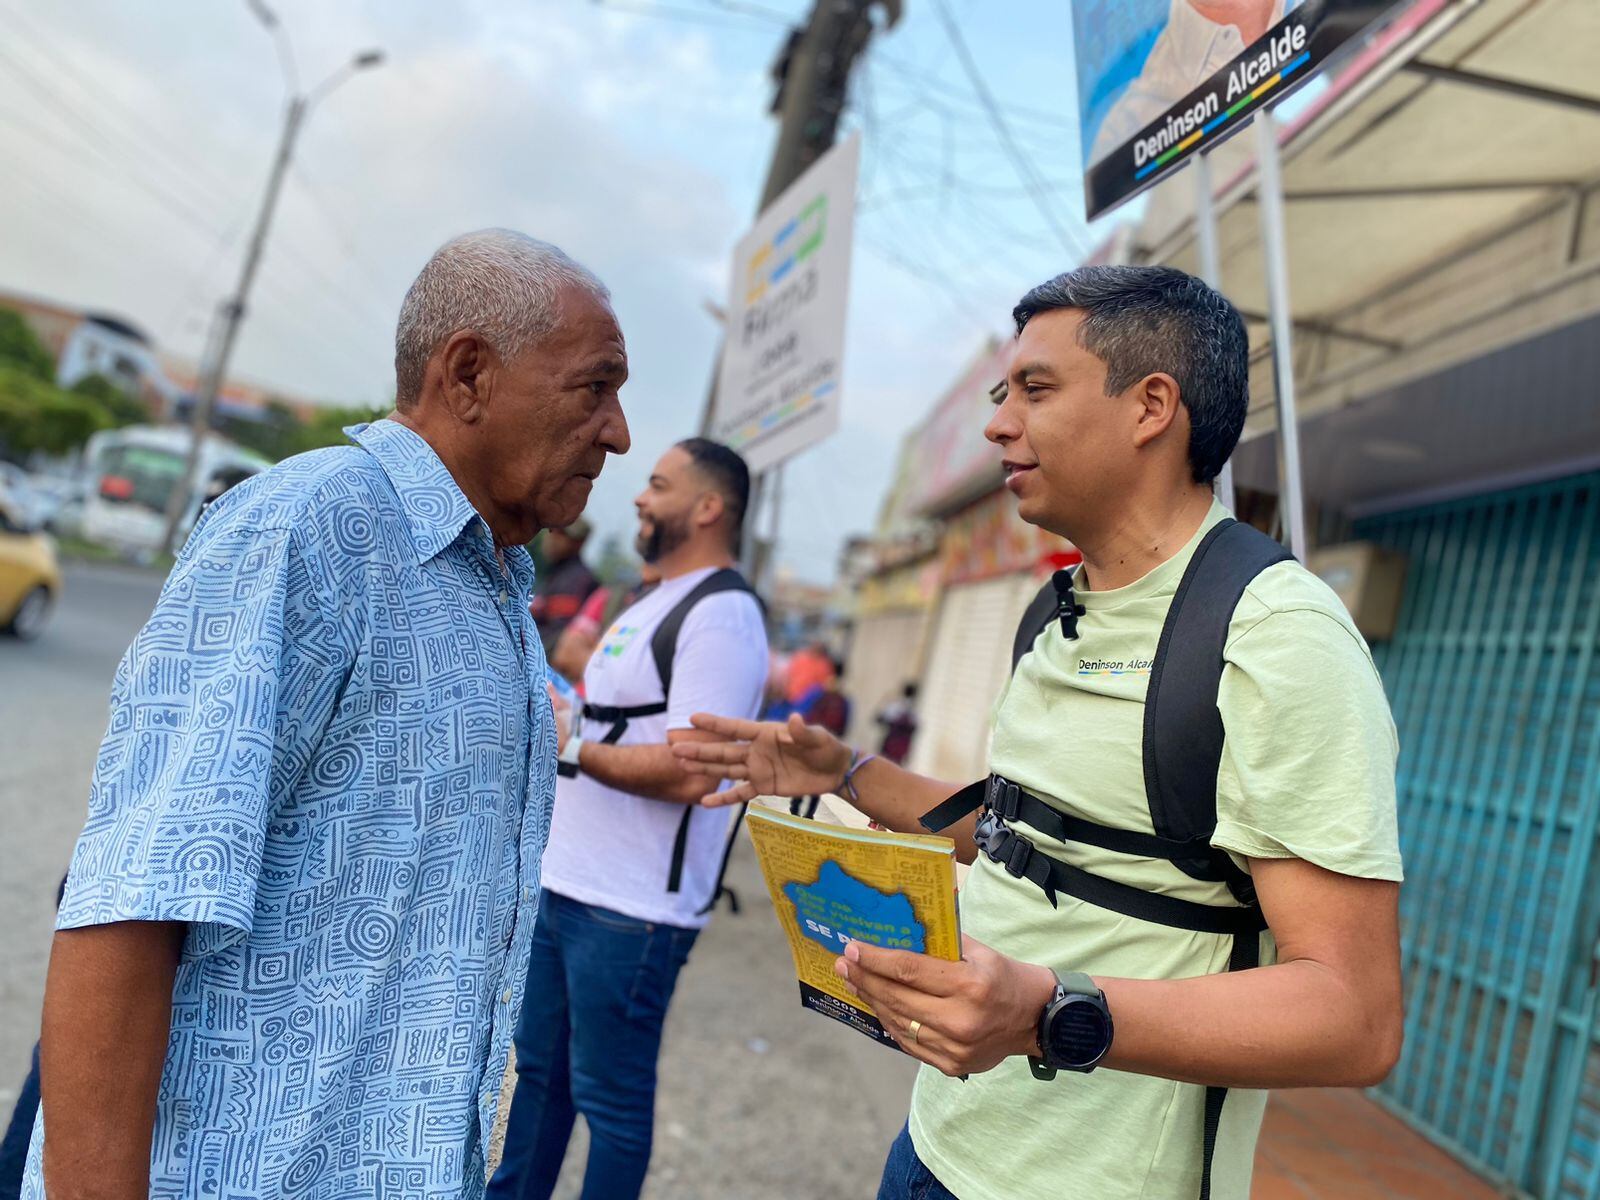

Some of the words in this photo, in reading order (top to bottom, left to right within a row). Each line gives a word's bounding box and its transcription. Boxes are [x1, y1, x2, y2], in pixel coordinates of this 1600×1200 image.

[1133, 91, 1219, 168] Deninson
[1225, 24, 1308, 104] Alcalde
[1078, 658, 1124, 670] Deninson
[805, 919, 833, 939] SE
[887, 937, 912, 948] no
